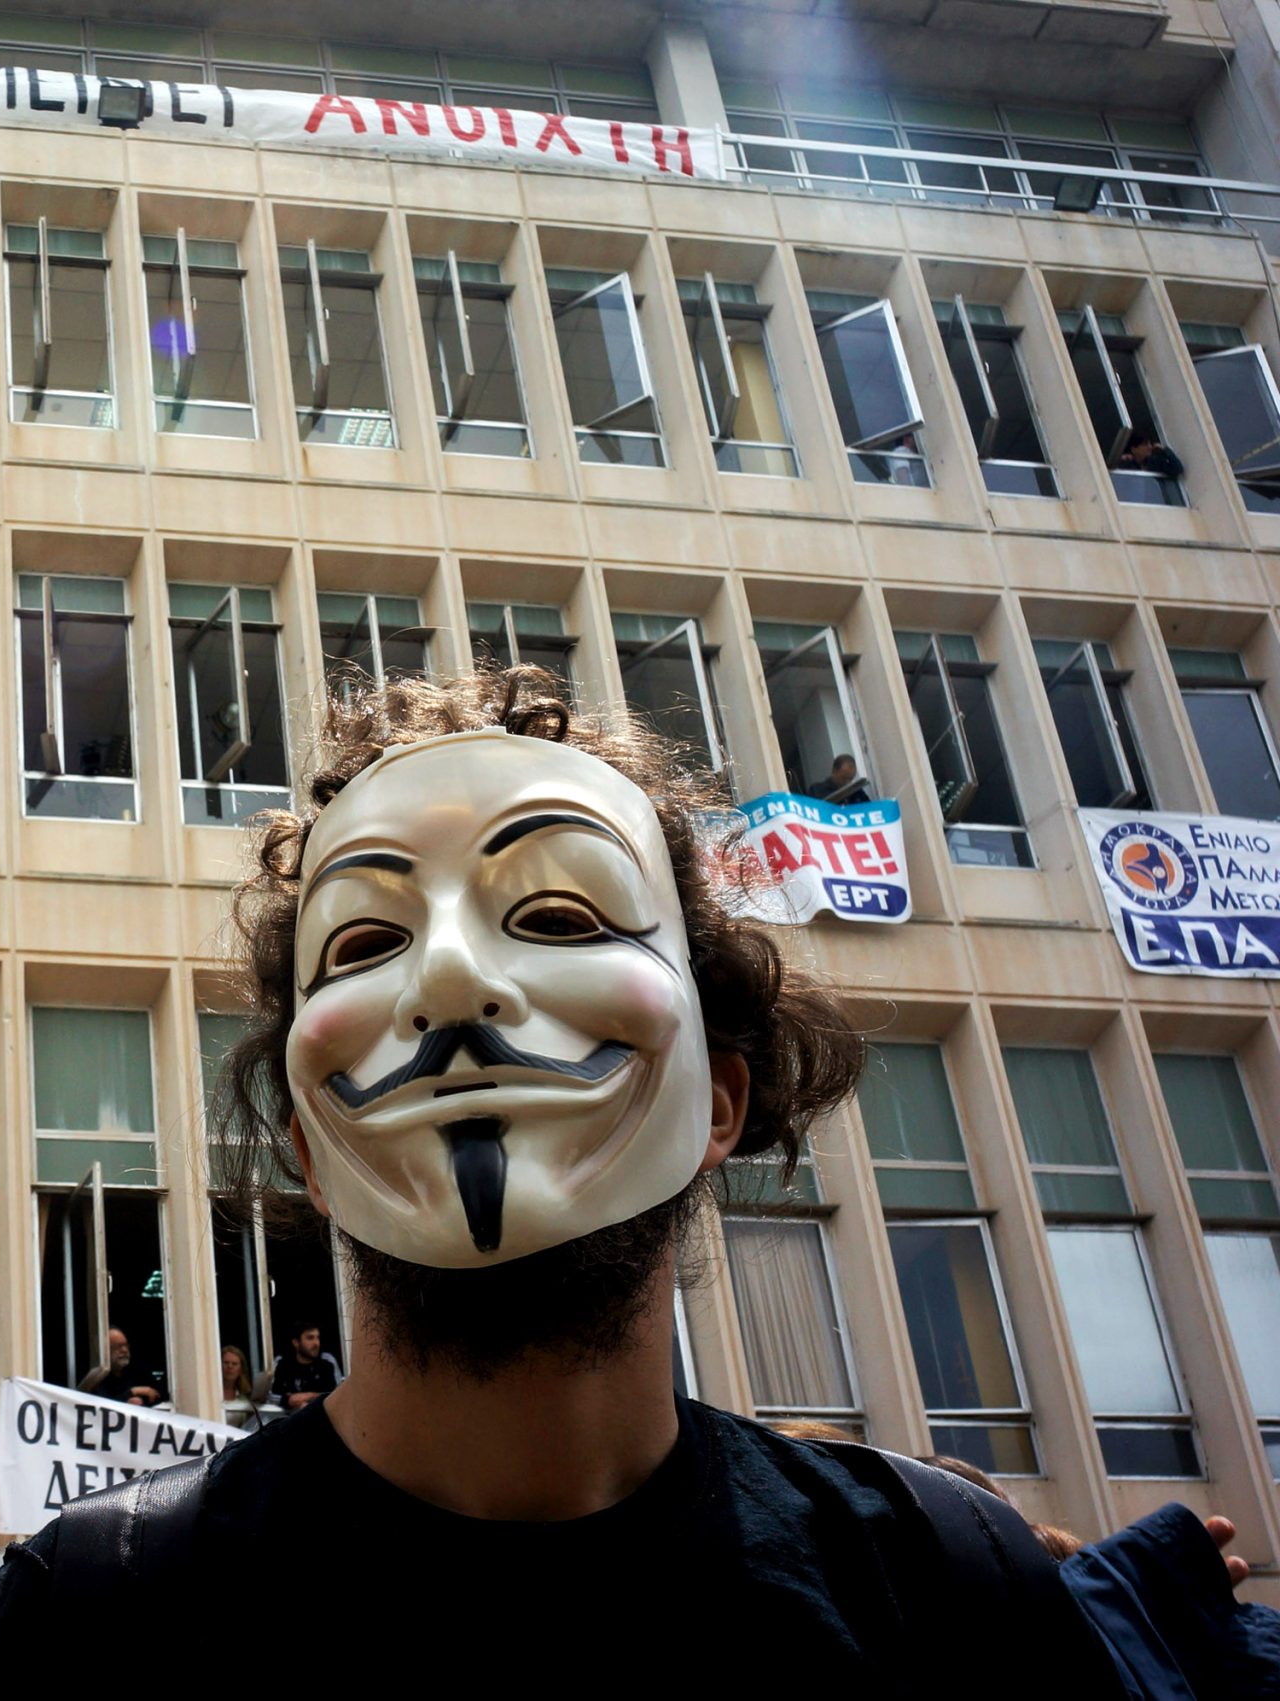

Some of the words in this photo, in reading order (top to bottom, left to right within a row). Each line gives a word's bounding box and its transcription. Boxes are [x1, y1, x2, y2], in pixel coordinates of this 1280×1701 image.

[831, 884, 889, 911] ΕΡΤ
[1209, 885, 1280, 911] ΜΕΤΩ
[17, 1400, 58, 1446] ΟΙ
